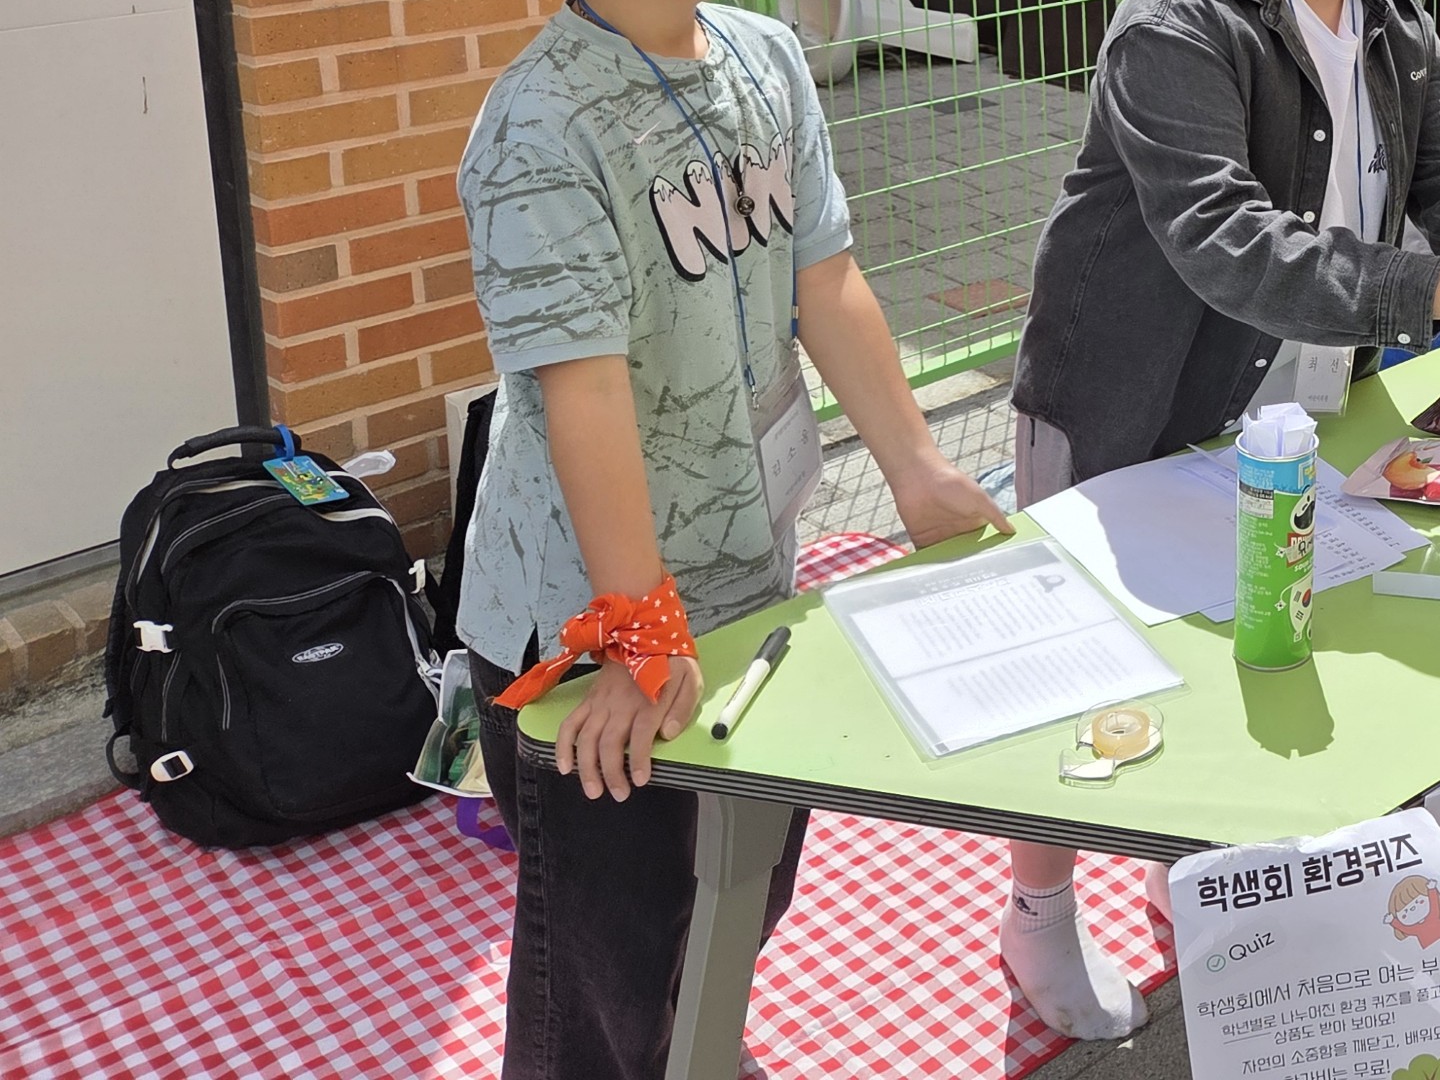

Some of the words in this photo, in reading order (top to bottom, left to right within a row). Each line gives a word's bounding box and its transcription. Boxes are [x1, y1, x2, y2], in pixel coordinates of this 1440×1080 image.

[1197, 863, 1293, 912] 학생회
[1302, 833, 1423, 895] 환경퀴즈
[1229, 931, 1275, 961] Quiz
[1197, 983, 1291, 1018] 학생회에서
[1297, 968, 1372, 998] 처음으로
[1379, 964, 1414, 985] 여는
[1221, 1015, 1277, 1036] 학년별로
[1281, 1003, 1335, 1025] 나누어진
[1340, 998, 1367, 1014] 환경
[1372, 990, 1411, 1009] 퀴즈를
[1274, 1024, 1315, 1045] 상품도
[1319, 1019, 1347, 1036] 받아
[1351, 1012, 1395, 1031] 보아요!
[1242, 1053, 1285, 1074] 자연의
[1291, 1041, 1348, 1065] 소중함을
[1352, 1034, 1400, 1053] 깨닫고,
[1354, 1058, 1391, 1077] 무료!
